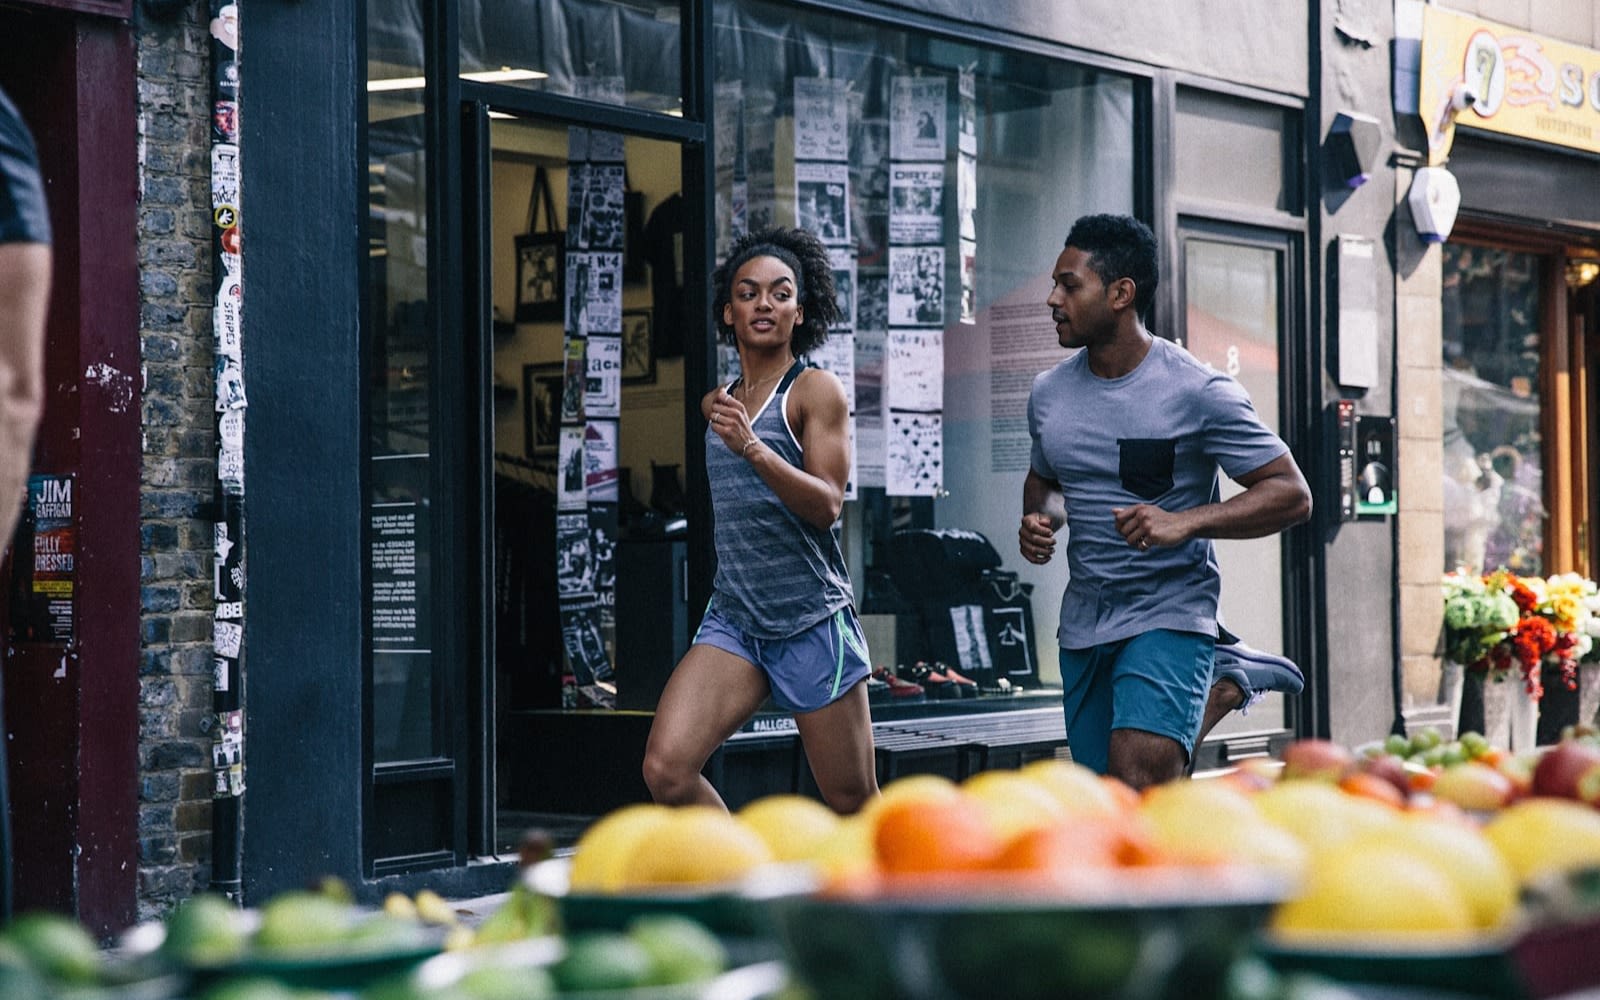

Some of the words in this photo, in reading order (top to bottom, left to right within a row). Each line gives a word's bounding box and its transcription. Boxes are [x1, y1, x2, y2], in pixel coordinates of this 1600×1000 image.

[36, 479, 71, 503] JIM
[36, 503, 71, 518] GAFFIGAN
[34, 535, 60, 553] FULLY
[35, 554, 74, 571] DRESSED
